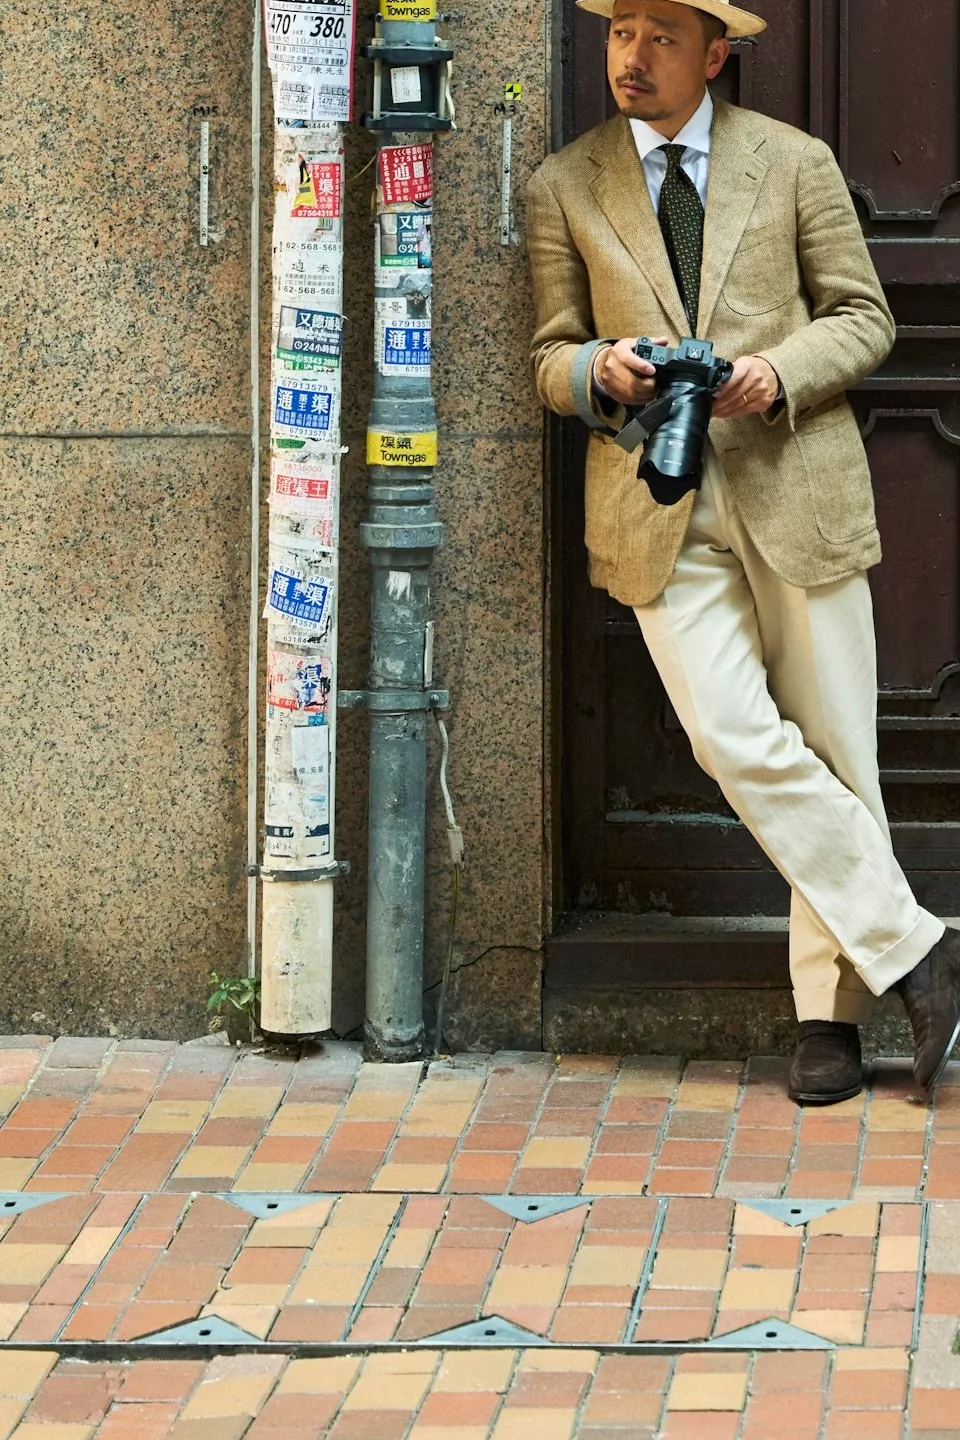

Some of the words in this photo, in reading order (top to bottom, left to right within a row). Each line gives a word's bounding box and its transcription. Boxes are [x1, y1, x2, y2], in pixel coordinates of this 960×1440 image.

[385, 5, 431, 18] Towngas
[310, 16, 345, 39] 380
[310, 66, 345, 76] 陳先生
[381, 152, 393, 201] 97564318
[392, 162, 411, 181] 通
[318, 178, 334, 196] 渠
[297, 209, 334, 217] 97564318
[285, 241, 337, 251] 62-568-568
[283, 285, 336, 295] 62-568-568
[387, 329, 407, 350] 通
[281, 380, 328, 392] 67913579
[277, 388, 294, 411] 通
[311, 393, 330, 415] 渠
[289, 427, 327, 438] 67913579
[380, 436, 412, 450] 煤氣
[380, 449, 427, 465] Towngas
[277, 475, 327, 498] 通渠王
[273, 573, 290, 597] 通
[303, 584, 325, 607] 渠
[281, 615, 317, 629] 67913579
[300, 667, 321, 688] 渠
